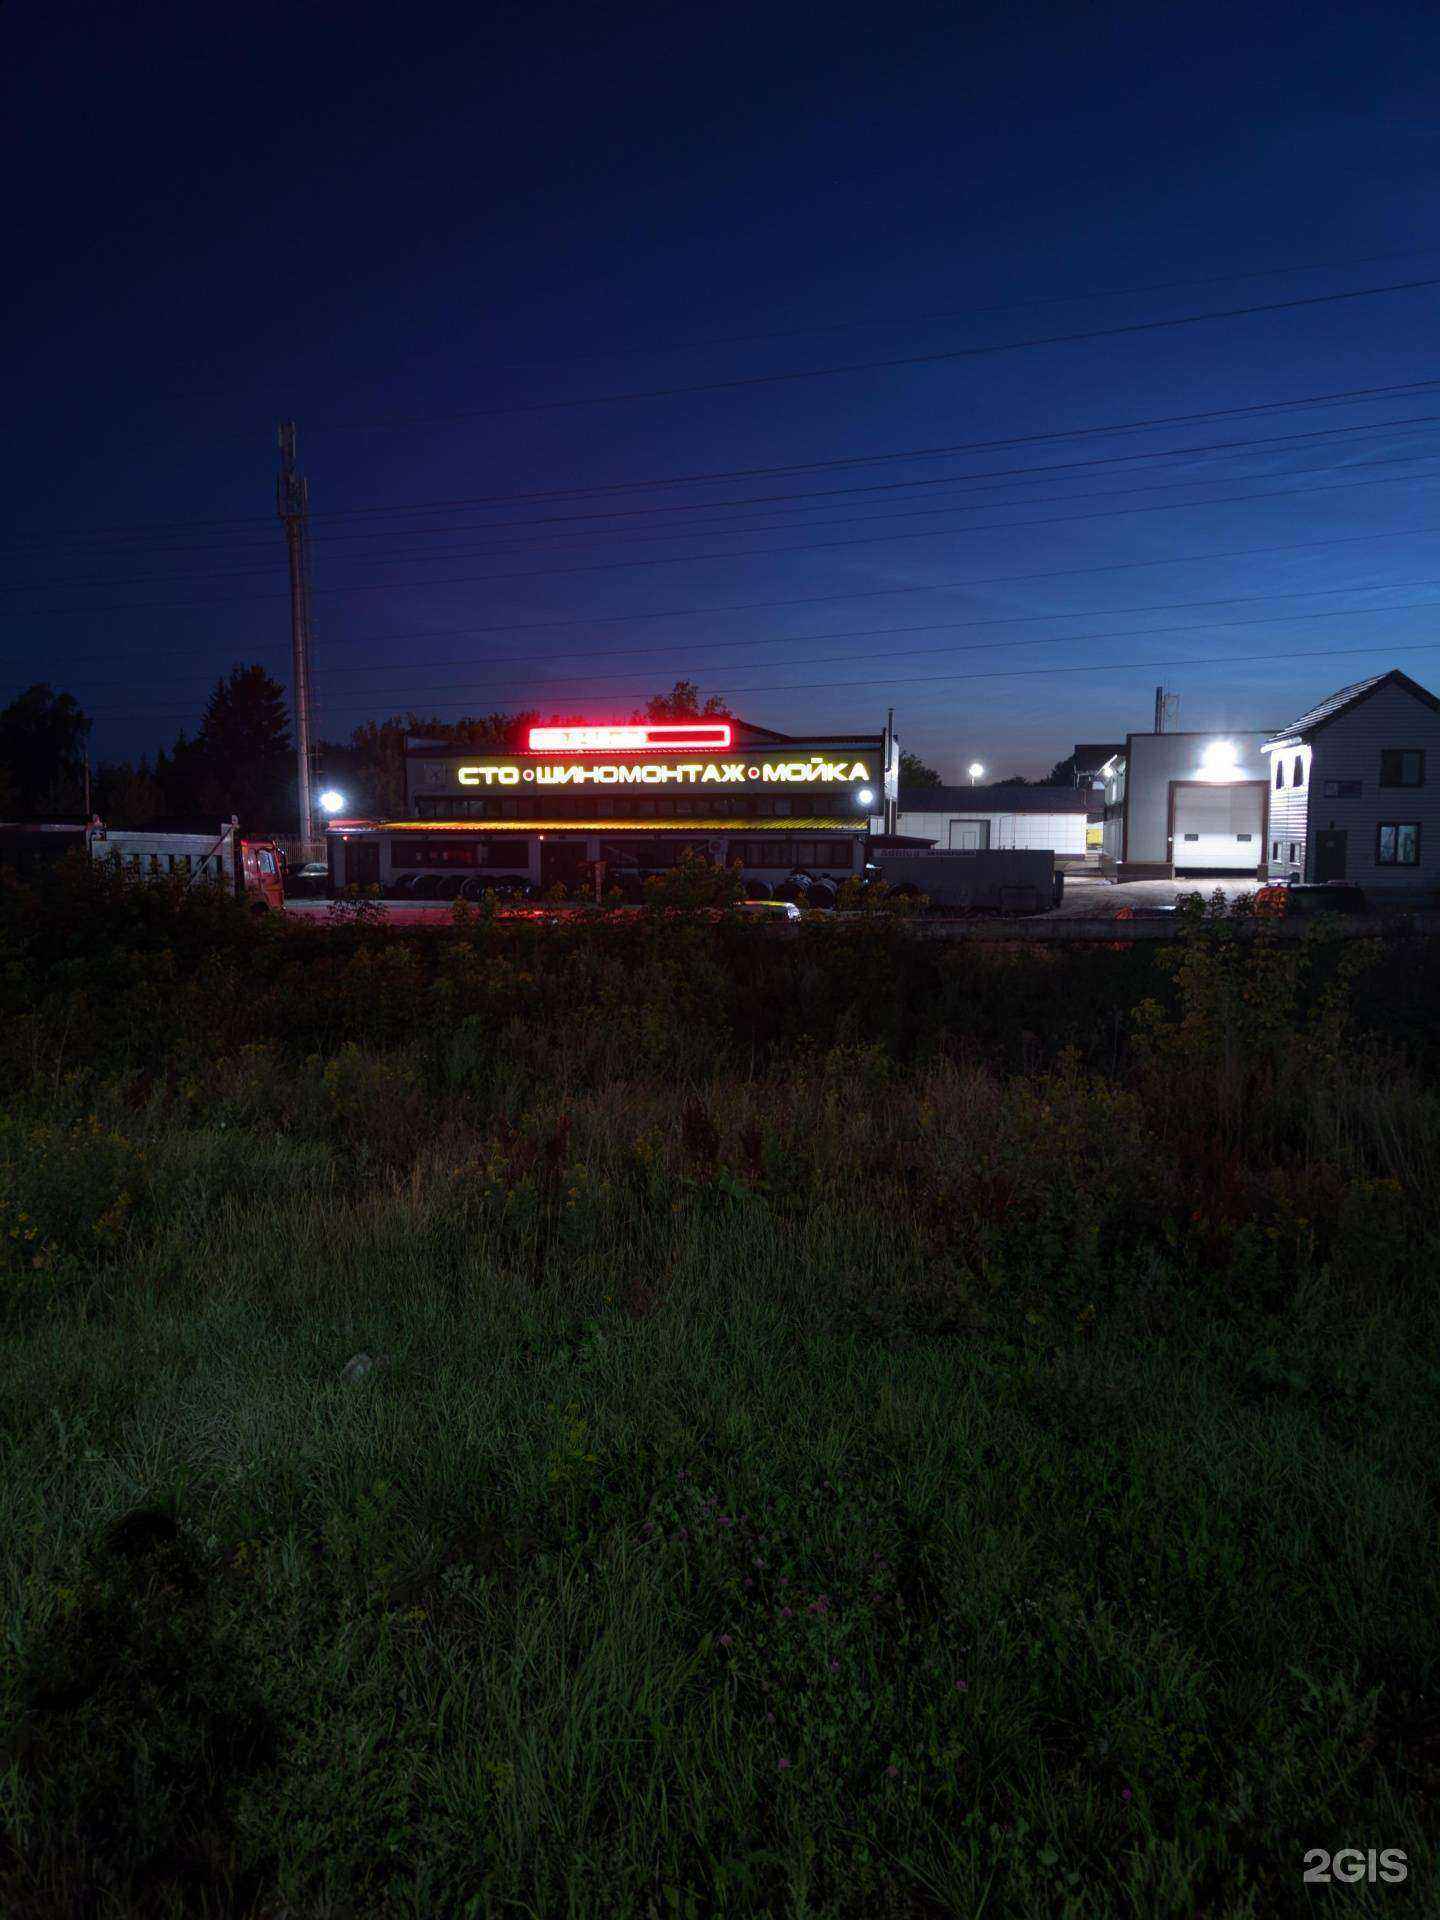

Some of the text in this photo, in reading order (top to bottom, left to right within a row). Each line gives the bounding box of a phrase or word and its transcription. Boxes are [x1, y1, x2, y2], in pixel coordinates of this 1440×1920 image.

[457, 757, 870, 785] СТО ШИНОМОНТАЖ МОЙКА
